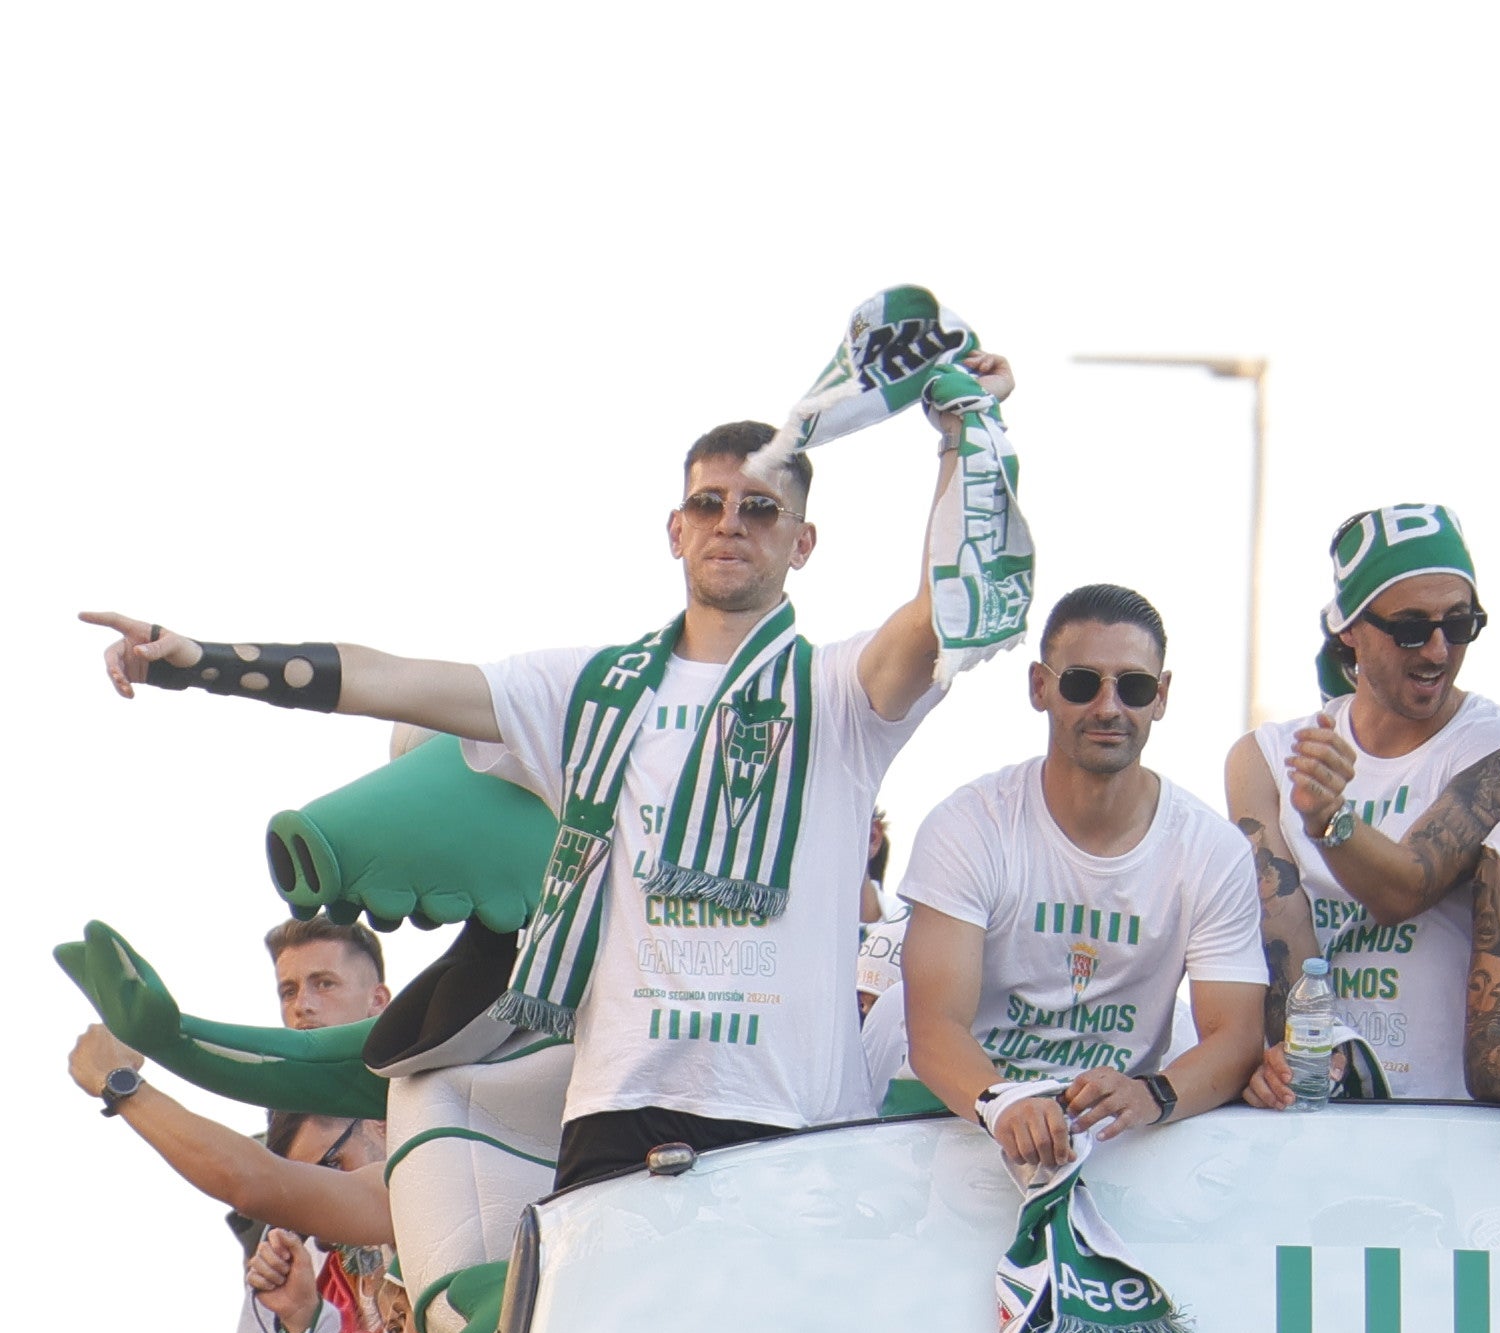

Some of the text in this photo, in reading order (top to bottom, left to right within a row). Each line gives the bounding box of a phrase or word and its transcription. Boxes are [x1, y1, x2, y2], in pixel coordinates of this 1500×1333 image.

[638, 939, 777, 976] GANAMOS
[633, 988, 666, 998] ASCENSO
[668, 990, 706, 1001] SEGUNDA
[708, 989, 744, 1002] DIVISIÓN
[1333, 968, 1400, 999] IMOS
[1007, 994, 1137, 1033] SENTIMOS
[983, 1027, 1133, 1074] LUCHAMOS
